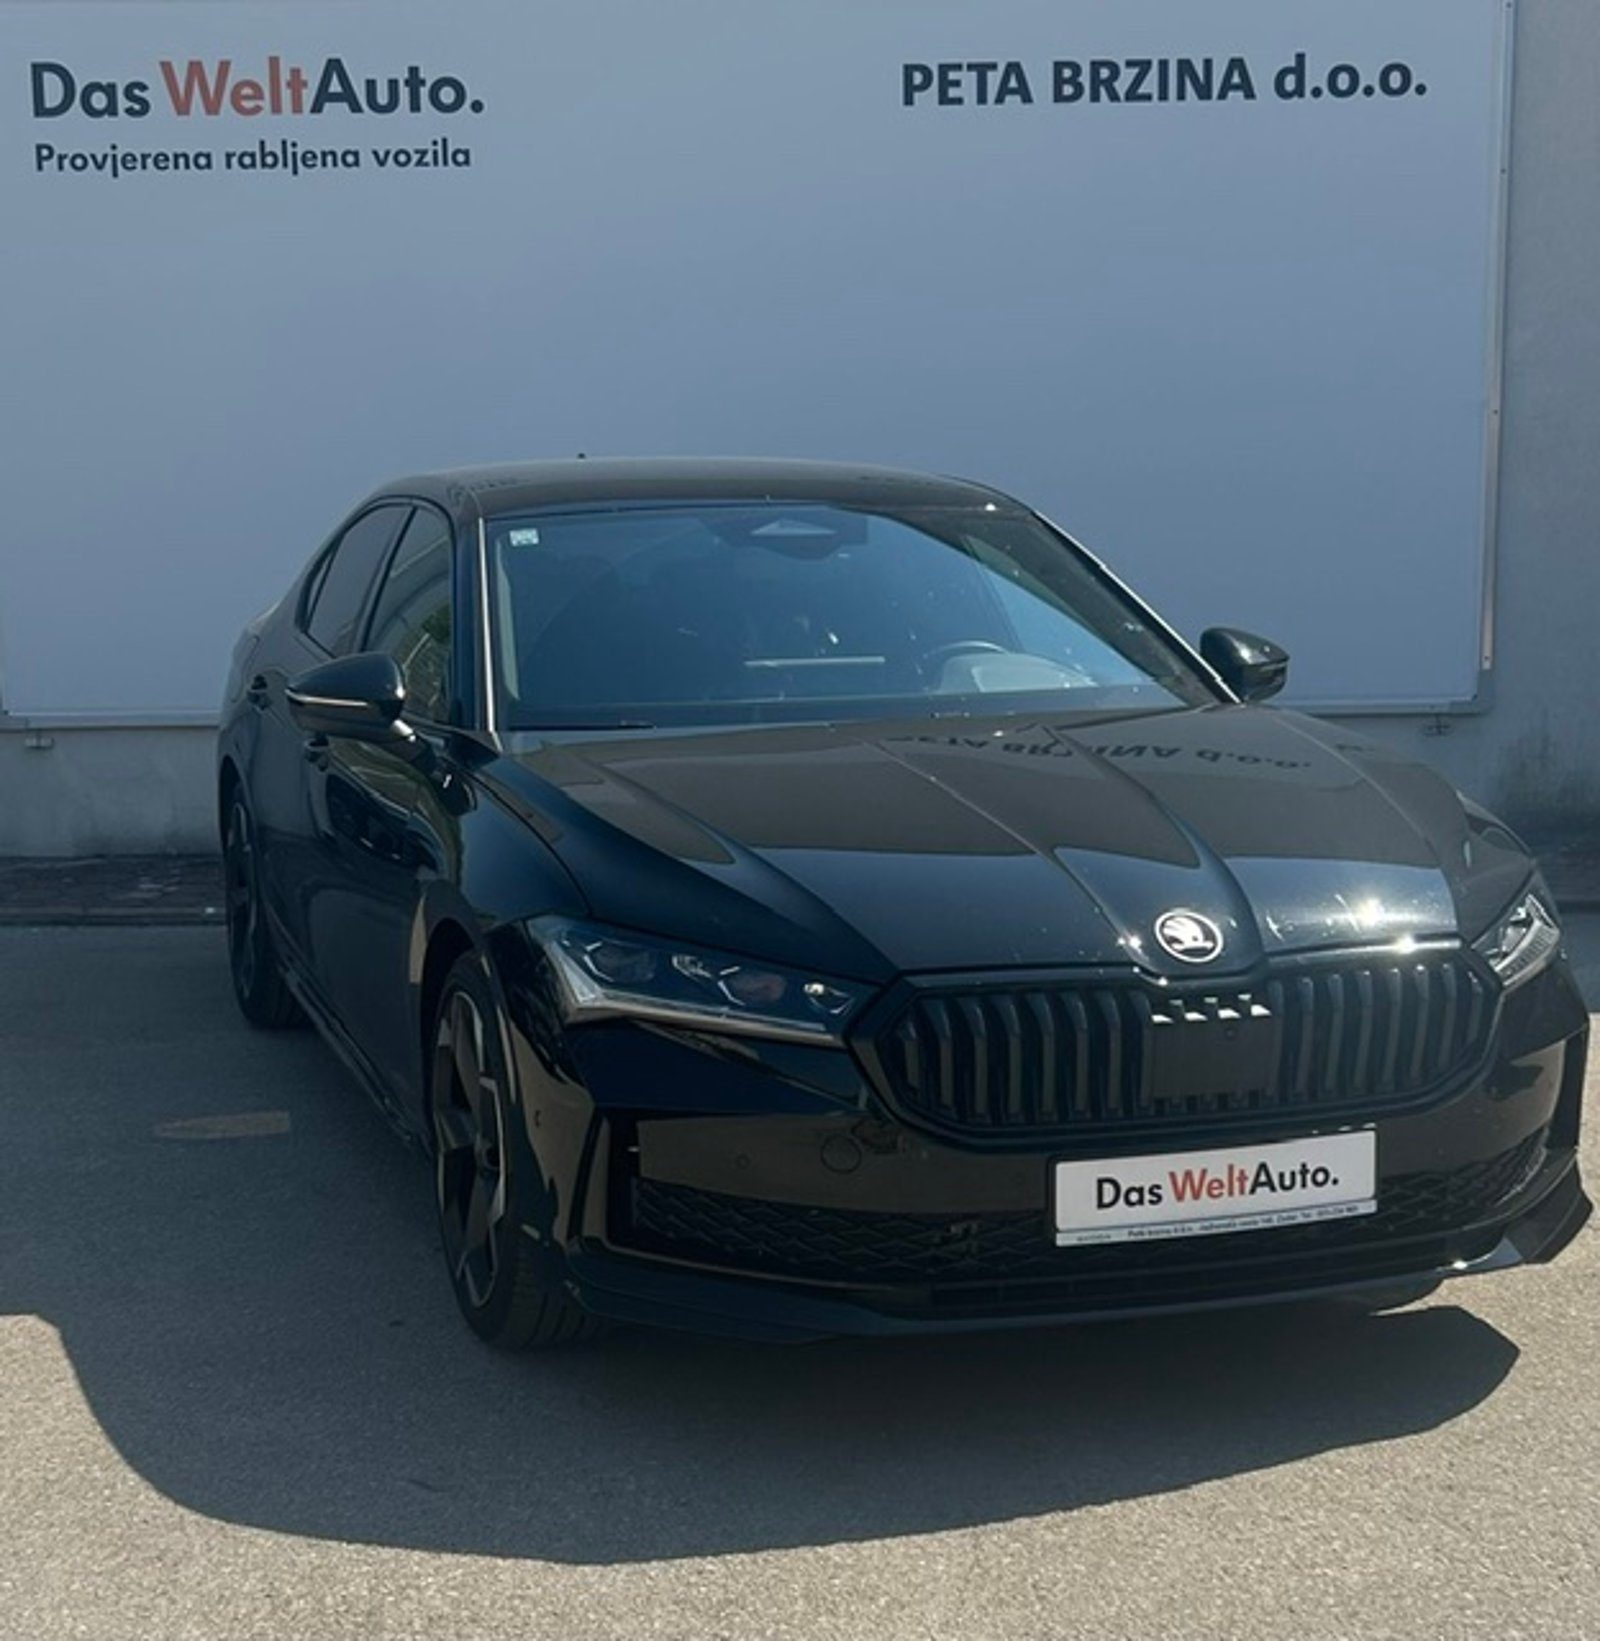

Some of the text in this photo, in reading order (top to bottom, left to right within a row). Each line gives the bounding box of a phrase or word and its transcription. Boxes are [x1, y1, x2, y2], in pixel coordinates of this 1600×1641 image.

[30, 55, 484, 119] Das WeltAuto.
[902, 52, 1427, 107] PETA BRZINA d.o.o.
[35, 136, 471, 179] Provjerena rabljena vozila
[1096, 1161, 1339, 1211] Das WeltAuto.
